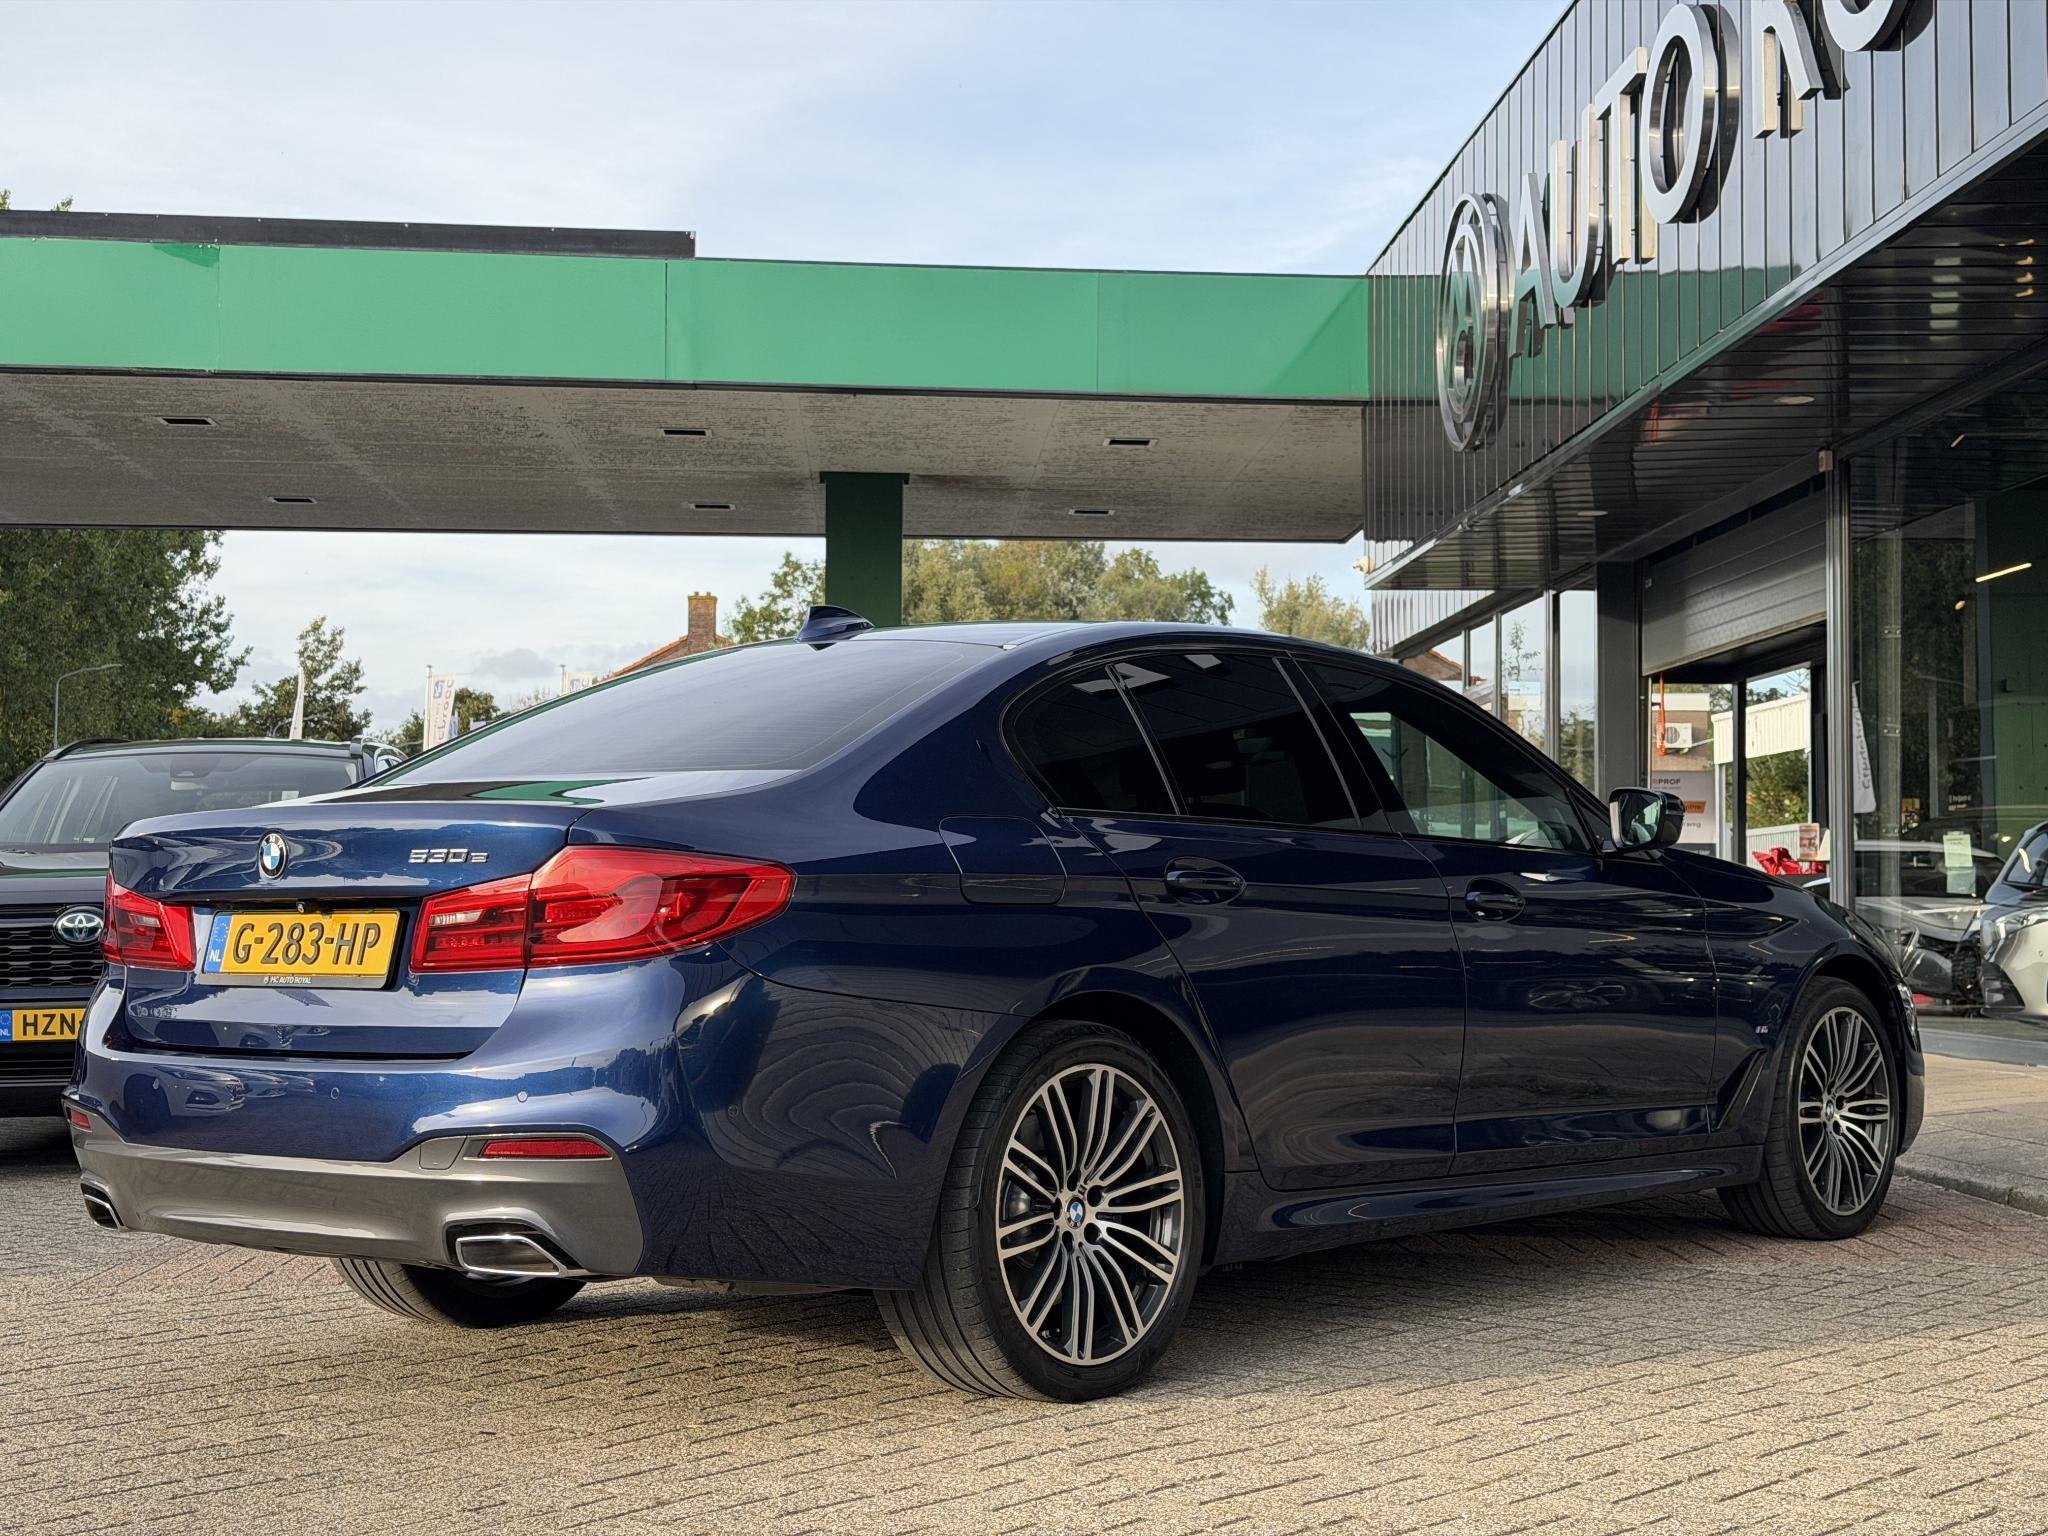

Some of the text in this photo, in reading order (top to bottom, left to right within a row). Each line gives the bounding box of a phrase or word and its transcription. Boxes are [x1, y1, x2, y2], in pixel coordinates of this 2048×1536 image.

[1509, 3, 1722, 358] AUTO
[209, 950, 221, 962] NL
[232, 922, 382, 966] G-283-HP
[279, 976, 295, 984] AUTO
[294, 976, 312, 984] ROYAL
[22, 1013, 85, 1037] HZN-
